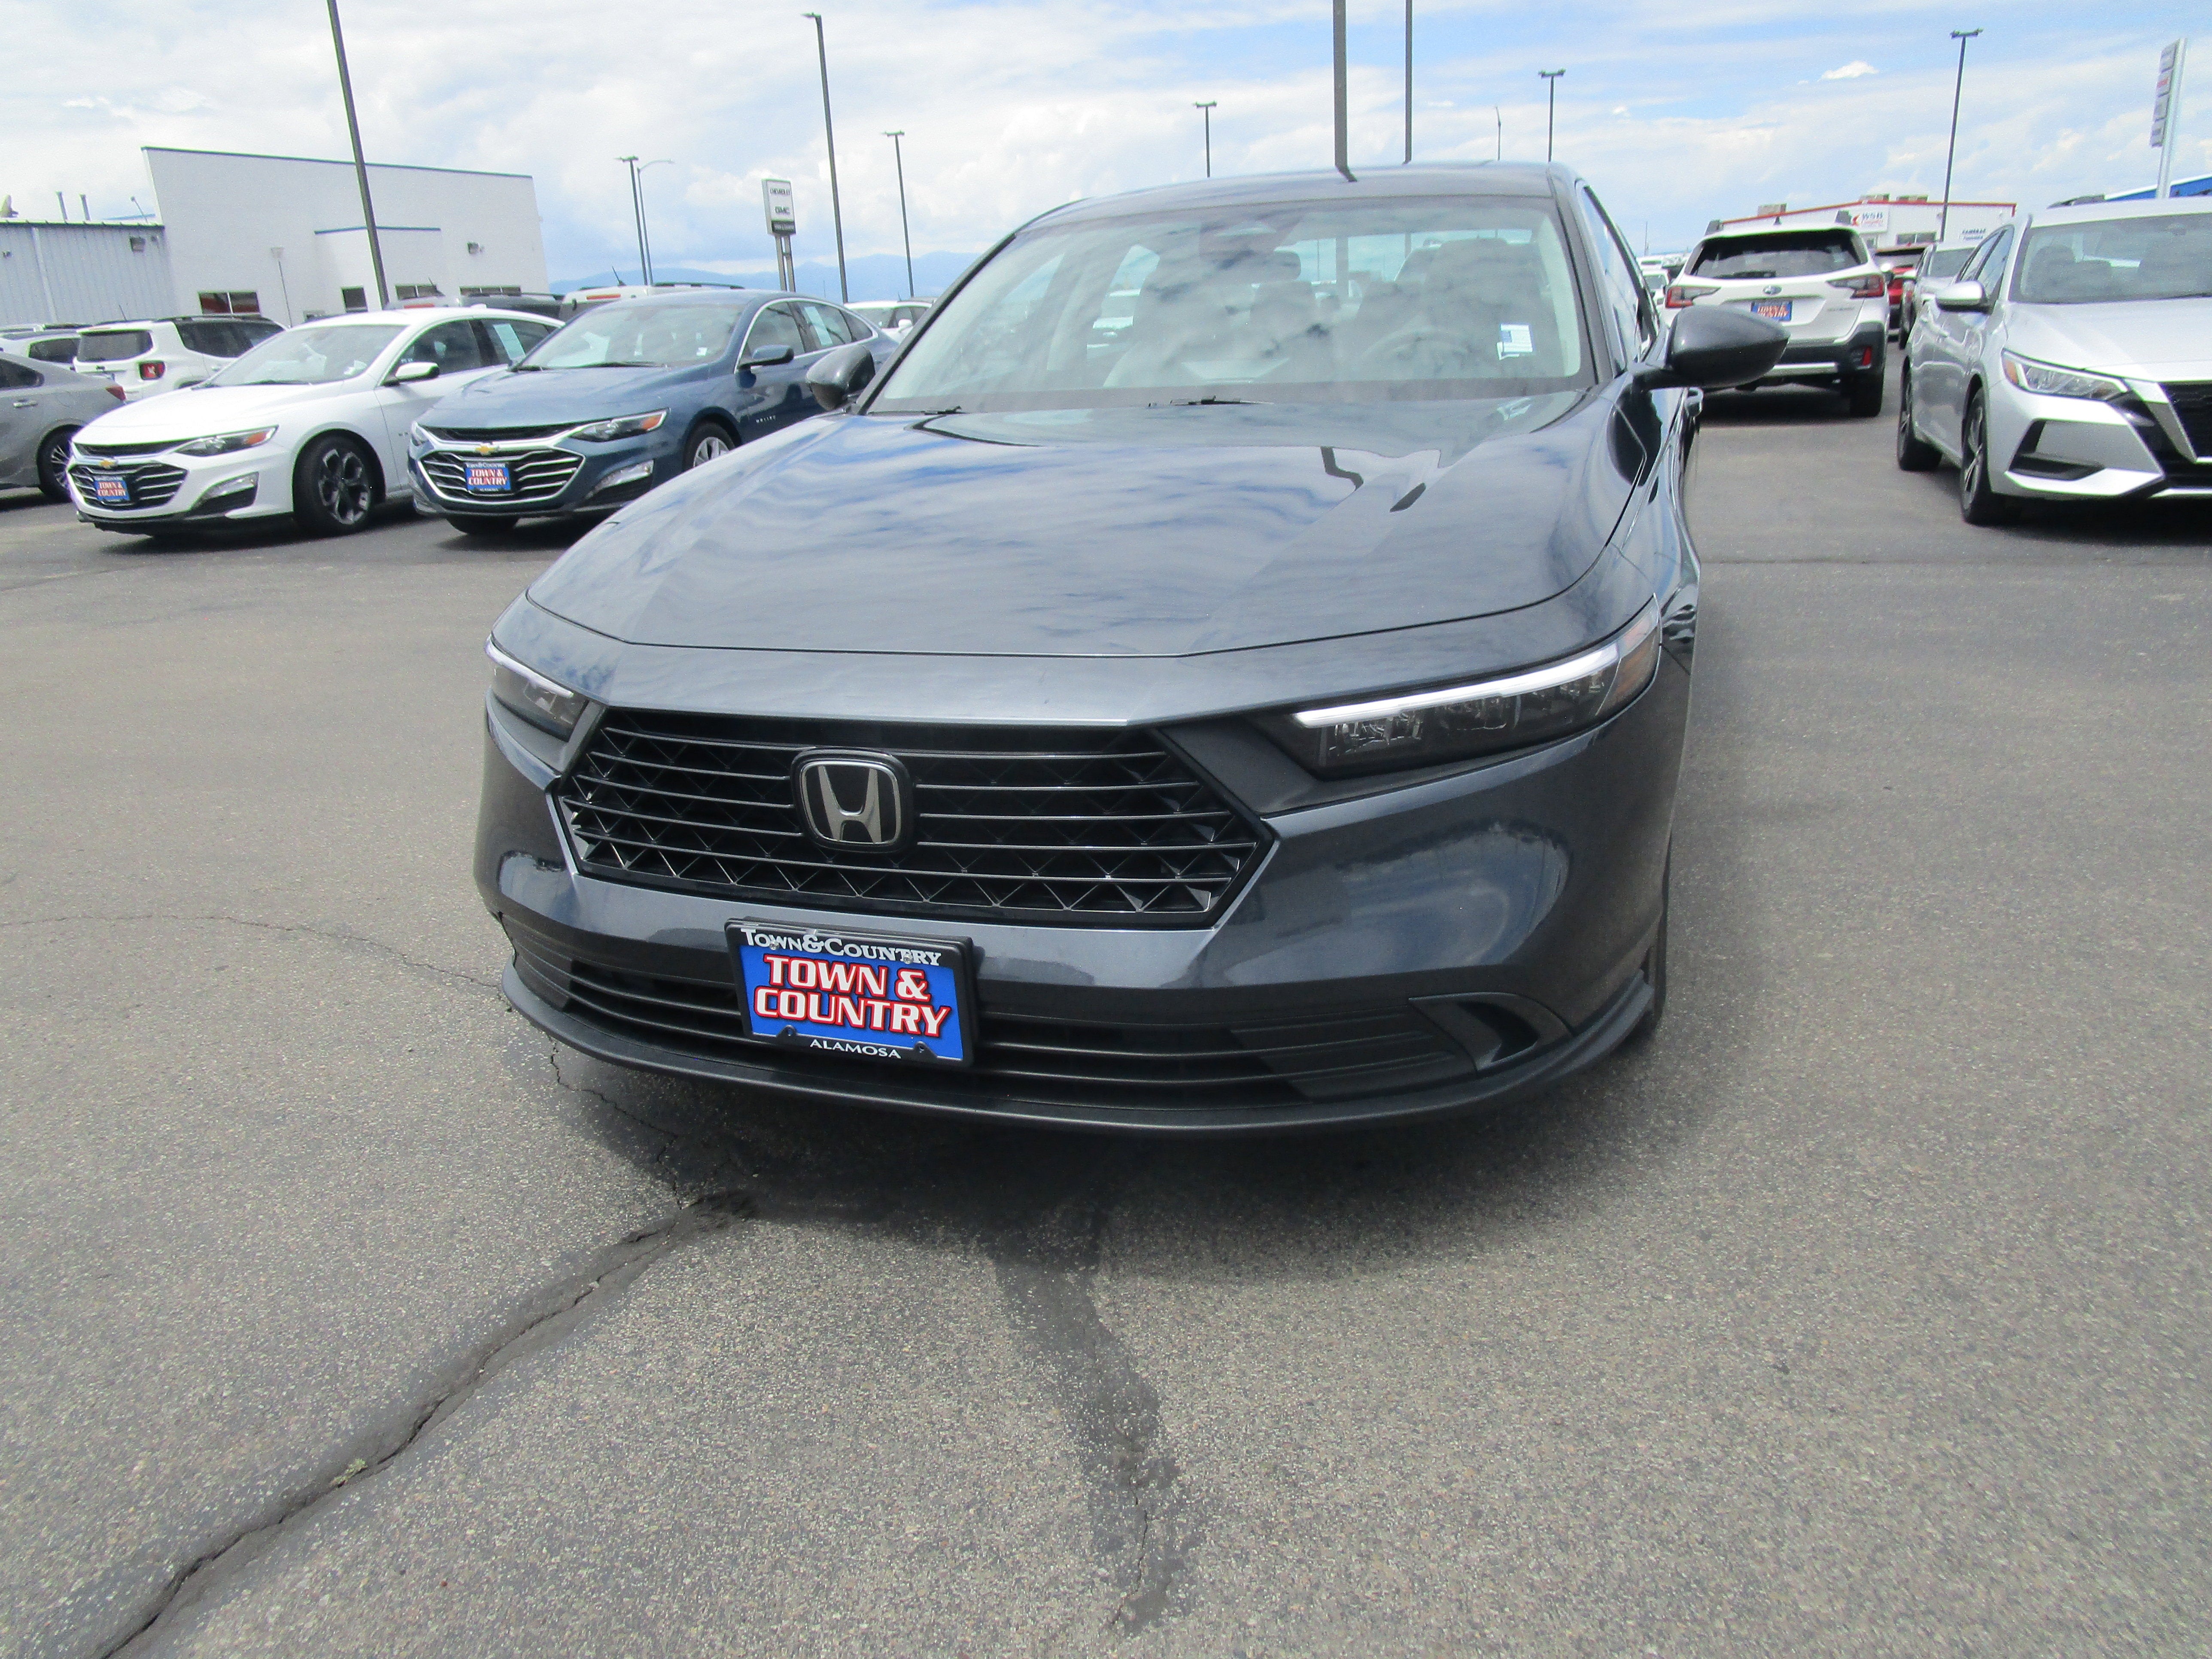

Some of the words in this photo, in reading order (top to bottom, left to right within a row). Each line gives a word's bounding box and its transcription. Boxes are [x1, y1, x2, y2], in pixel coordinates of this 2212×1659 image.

[775, 206, 790, 214] GMC
[471, 468, 495, 477] TOWN
[496, 468, 504, 477] &
[468, 476, 507, 486] COUNTRY
[763, 954, 888, 997] TOWN
[895, 968, 931, 1003] &
[754, 987, 951, 1038] COUNTRY
[810, 1039, 902, 1059] ALAMOSA
